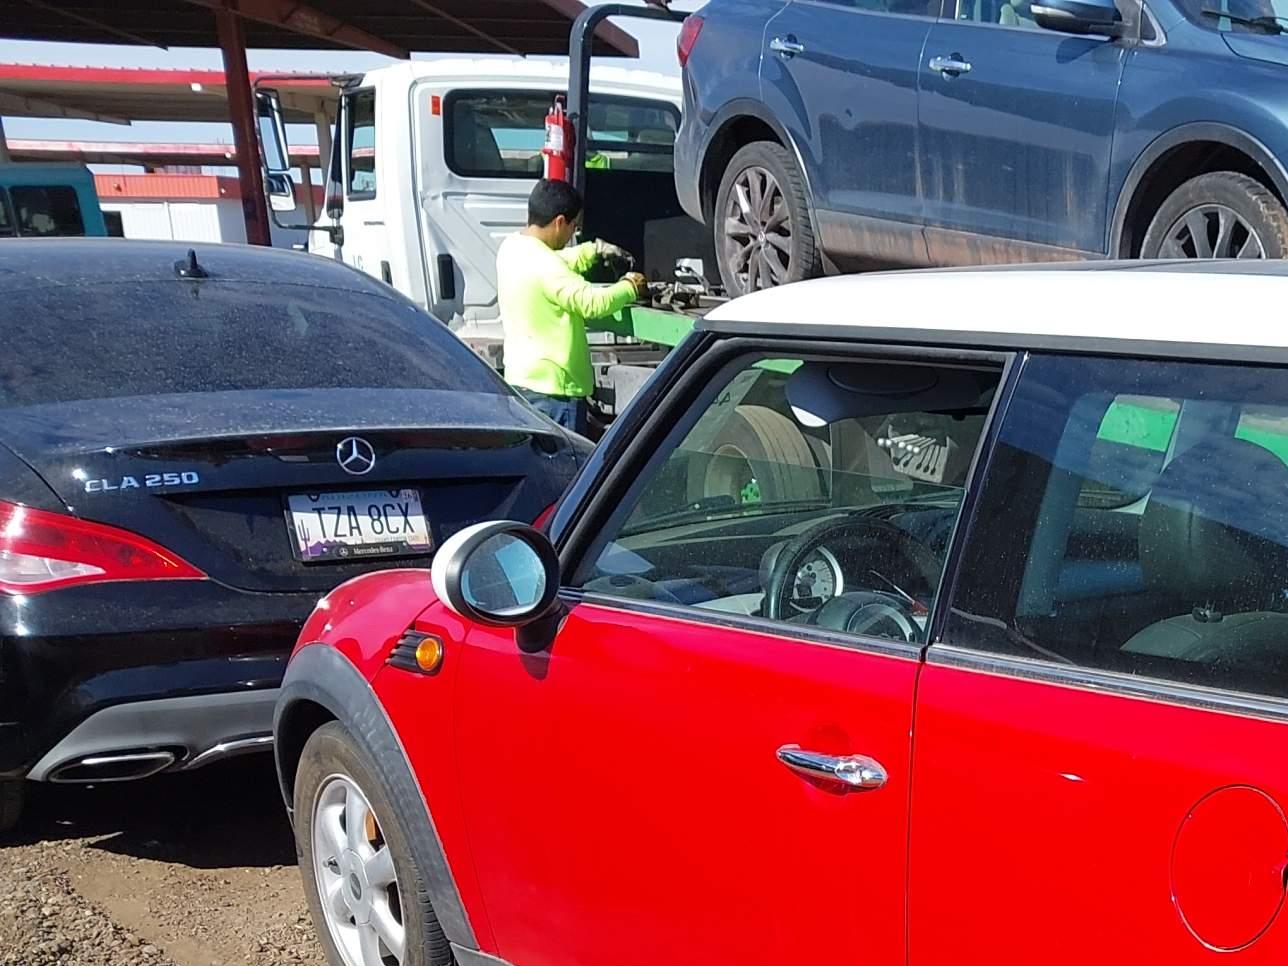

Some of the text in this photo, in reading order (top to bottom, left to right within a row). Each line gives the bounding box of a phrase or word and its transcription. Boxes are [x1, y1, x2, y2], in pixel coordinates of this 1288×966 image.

[85, 472, 200, 493] CLA 250
[312, 502, 415, 539] TZA 8CX
